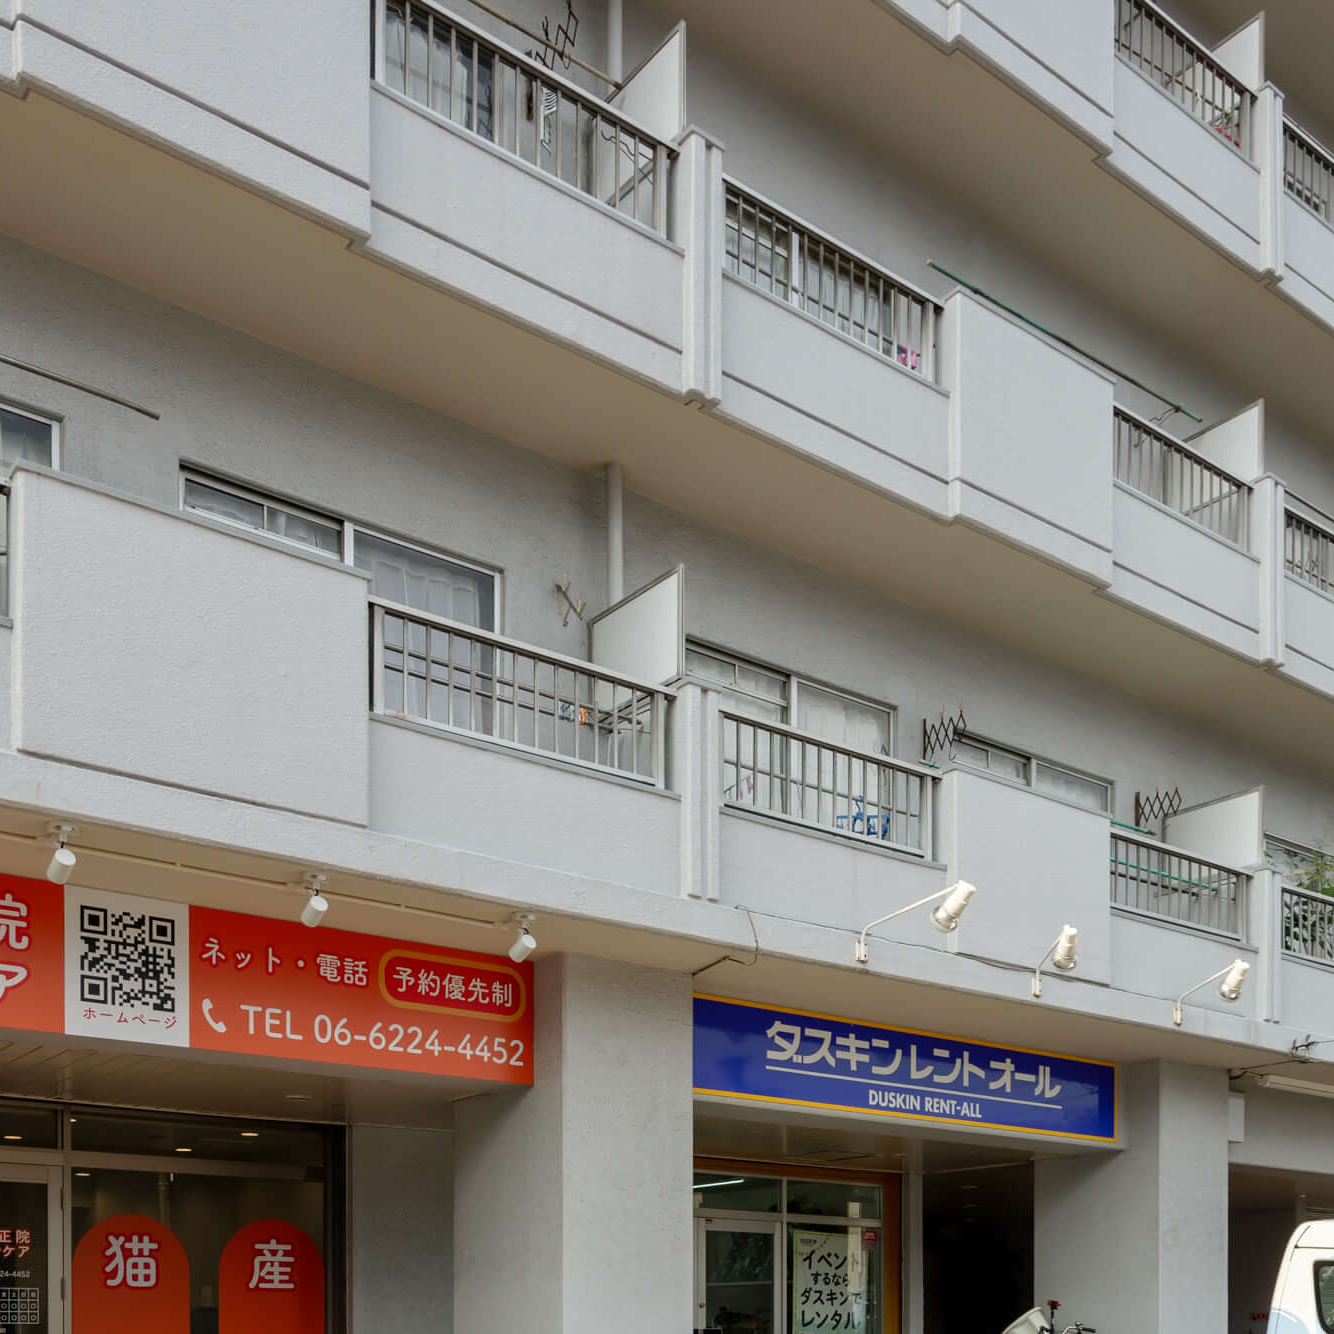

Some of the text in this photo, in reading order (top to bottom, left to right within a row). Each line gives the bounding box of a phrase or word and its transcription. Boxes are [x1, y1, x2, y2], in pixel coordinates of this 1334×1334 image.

[201, 937, 369, 986] ネット・電話
[392, 966, 513, 1008] 予約優先制
[82, 1006, 178, 1030] ホームページ
[240, 1004, 524, 1068] TEL 06-6224-4452
[868, 1089, 982, 1119] DUSKIN RENT-ALL
[802, 1249, 860, 1273] イベント
[801, 1287, 863, 1306] ダスキンで
[801, 1309, 861, 1330] レンタル
